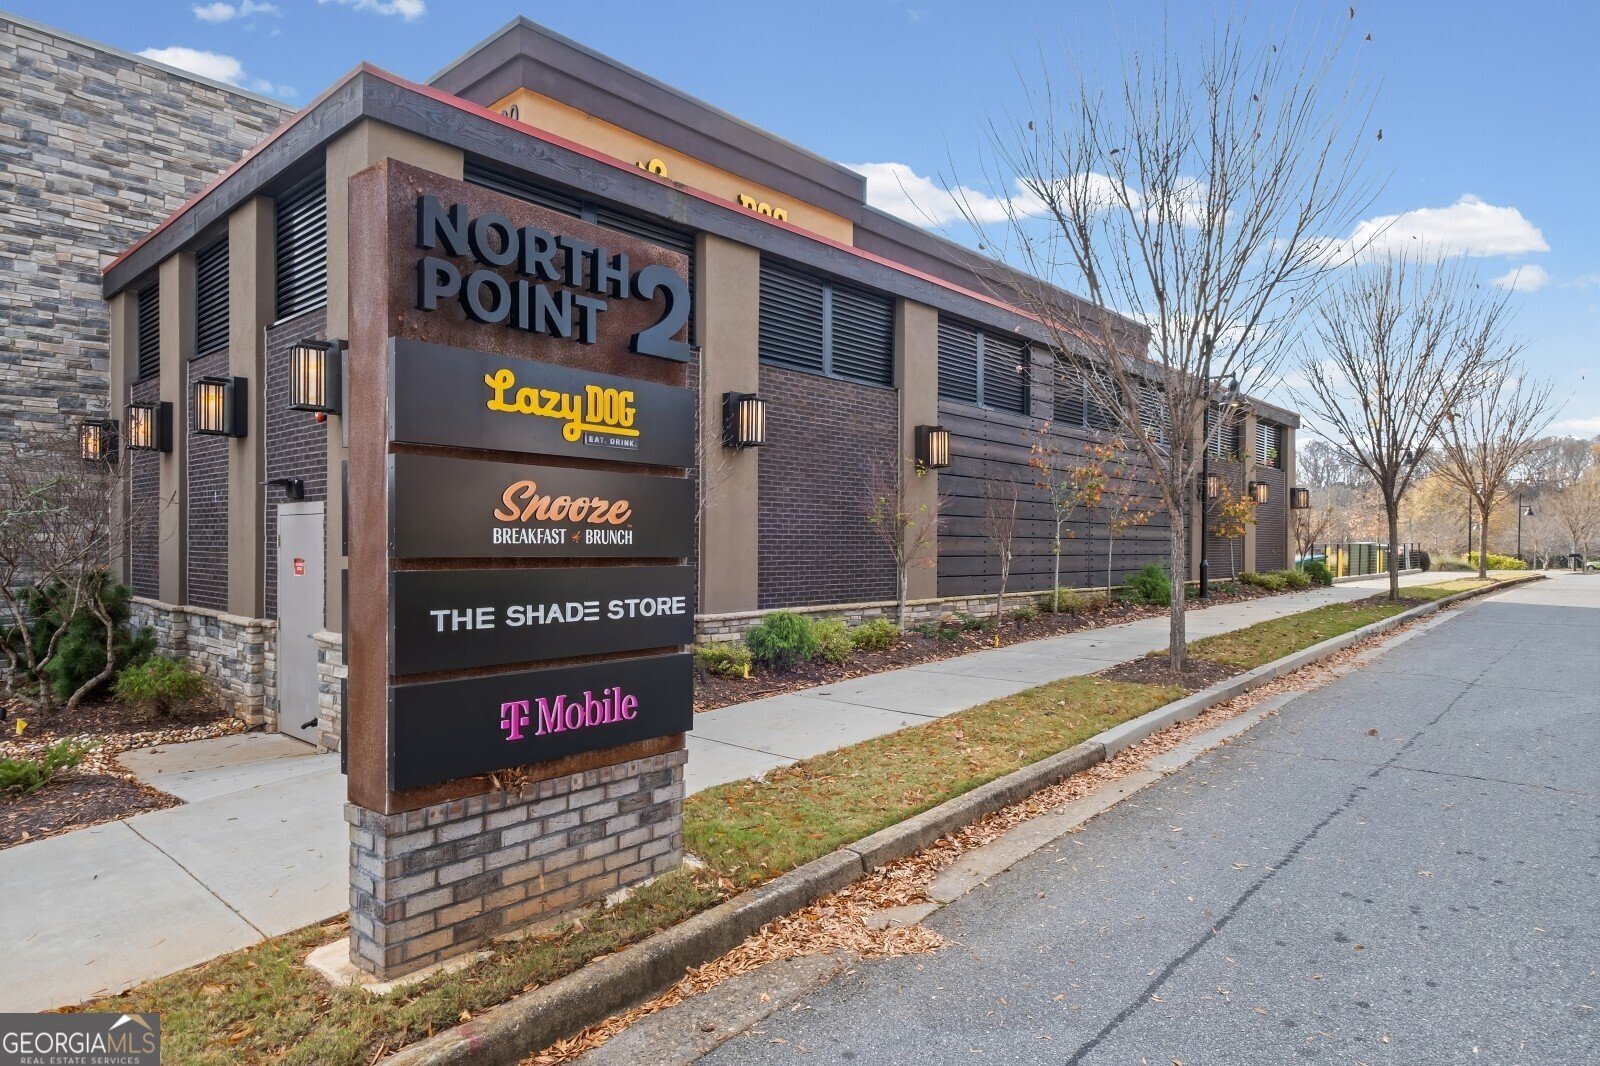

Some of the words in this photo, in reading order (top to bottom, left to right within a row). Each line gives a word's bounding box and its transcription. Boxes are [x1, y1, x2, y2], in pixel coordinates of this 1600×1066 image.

[416, 194, 629, 299] NORTH
[416, 256, 607, 344] POINT
[628, 265, 691, 363] 2
[484, 369, 582, 442] Lazy
[586, 385, 636, 427] DOG
[588, 435, 607, 444] EAT.
[610, 437, 637, 448] DRINK.
[493, 480, 632, 525] Snooze
[493, 528, 567, 544] BREAKFAST
[585, 529, 633, 545] BRUNCH
[430, 607, 495, 632] THE
[505, 601, 600, 627] SHADE
[607, 596, 686, 620] STORE
[535, 687, 639, 737] Mobile
